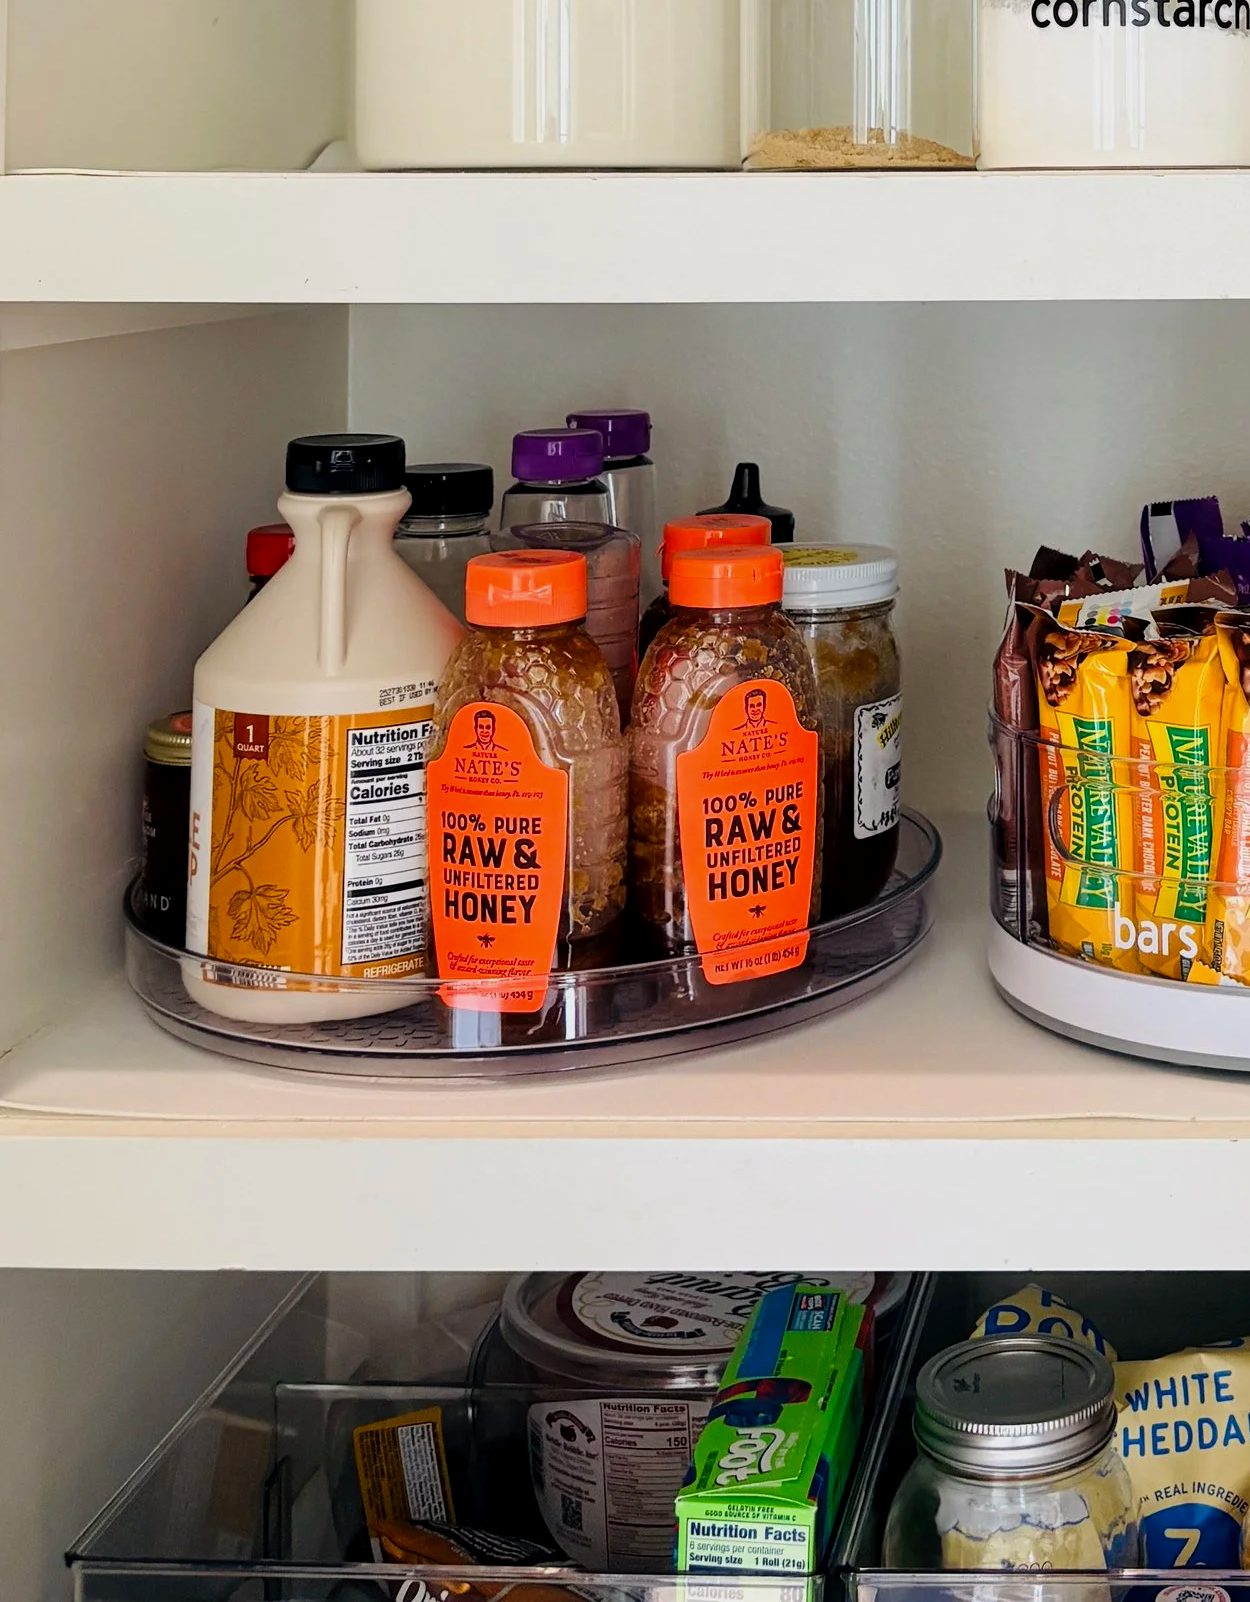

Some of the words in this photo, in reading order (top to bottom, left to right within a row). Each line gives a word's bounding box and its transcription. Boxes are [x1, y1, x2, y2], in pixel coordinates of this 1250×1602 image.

[245, 724, 254, 743] 1
[352, 728, 418, 746] Nutrition
[721, 731, 788, 756] NATE'S
[237, 742, 265, 753] QUART
[351, 747, 374, 757] About
[375, 745, 385, 754] 32
[350, 756, 383, 769] Serving
[385, 755, 401, 765] size
[455, 758, 522, 776] NATE'S
[1077, 726, 1112, 816] NATURE
[350, 782, 410, 799] Calories
[1171, 735, 1211, 827] NATURE
[703, 791, 757, 815] 100%
[766, 781, 803, 806] PURE
[350, 817, 368, 826] Total
[369, 814, 381, 823] Fat
[442, 811, 486, 832] 100%
[495, 817, 541, 834] PURE
[705, 808, 777, 848] RAW
[782, 803, 802, 834] &
[1141, 813, 1155, 839] DARK
[349, 828, 376, 838] Sodium
[349, 842, 367, 850] Total
[369, 835, 414, 848] Carbohydrate
[443, 832, 507, 868] RAW
[514, 838, 541, 869] &
[707, 836, 801, 868] UNFILTERED
[1082, 819, 1116, 903] VALLEY
[348, 879, 373, 887] Protein
[444, 868, 539, 890] UNFILTERED
[708, 855, 799, 901] HONEY
[1178, 832, 1209, 913] VALLEY
[444, 888, 536, 924] HONEY
[1115, 901, 1198, 959] bars
[364, 957, 425, 978] REFRIGERATE
[1125, 1370, 1234, 1412] WHITE
[604, 1403, 650, 1413] Nutrition
[653, 1405, 686, 1413] Facts
[667, 1436, 687, 1447] 150
[1155, 1481, 1188, 1502] REAL
[763, 1513, 790, 1521] VITAMIN
[690, 1522, 757, 1540] Nutrition
[765, 1526, 806, 1542] Facts
[697, 1543, 730, 1553] servings
[732, 1545, 745, 1554] per
[747, 1546, 784, 1556] container
[1164, 1527, 1201, 1566] 7
[689, 1552, 722, 1564] Serving
[725, 1555, 742, 1564] size
[762, 1558, 779, 1567] Roll
[782, 1558, 806, 1570] (21g)
